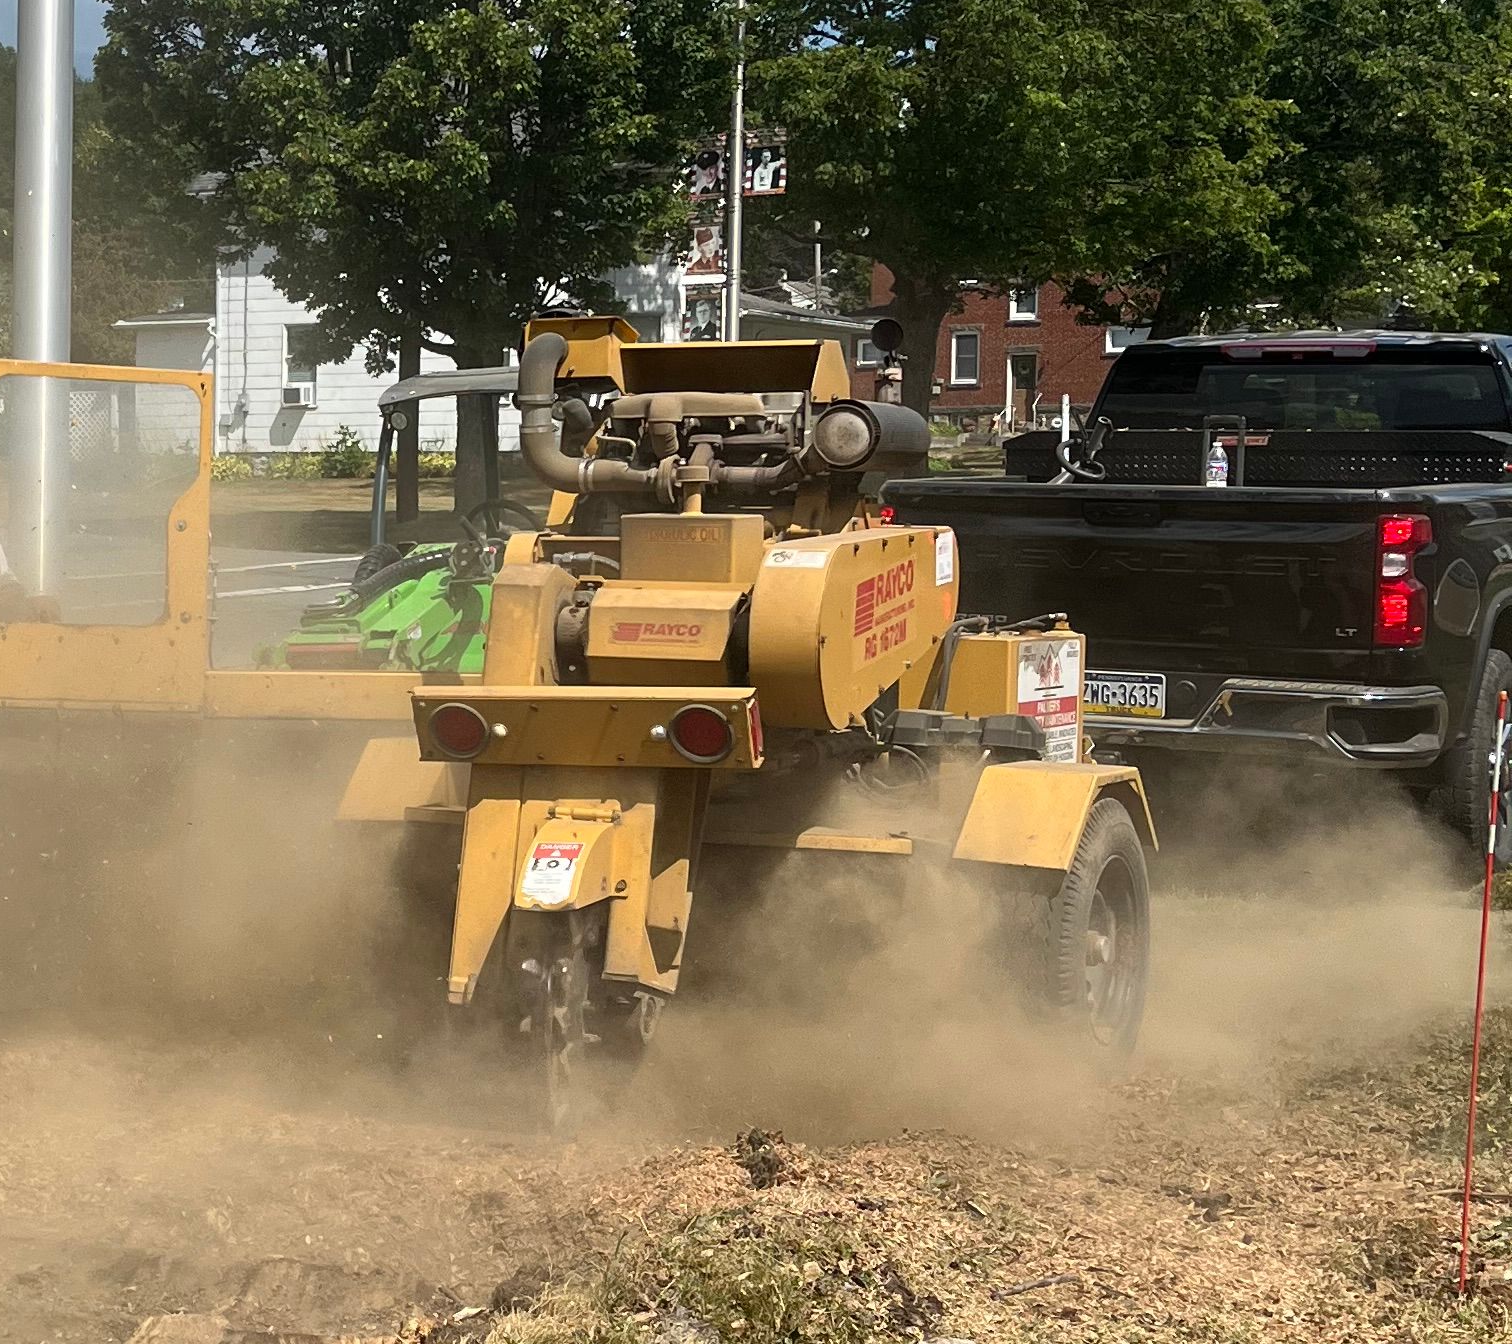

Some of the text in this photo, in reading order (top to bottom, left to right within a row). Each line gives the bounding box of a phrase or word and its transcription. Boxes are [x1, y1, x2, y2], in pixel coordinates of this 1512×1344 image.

[699, 527, 719, 541] OIL
[876, 559, 914, 607] RAYCO
[643, 624, 701, 637] RAYCO
[1335, 628, 1359, 637] LT
[865, 633, 877, 660] RG
[1106, 705, 1133, 714] TRUCK
